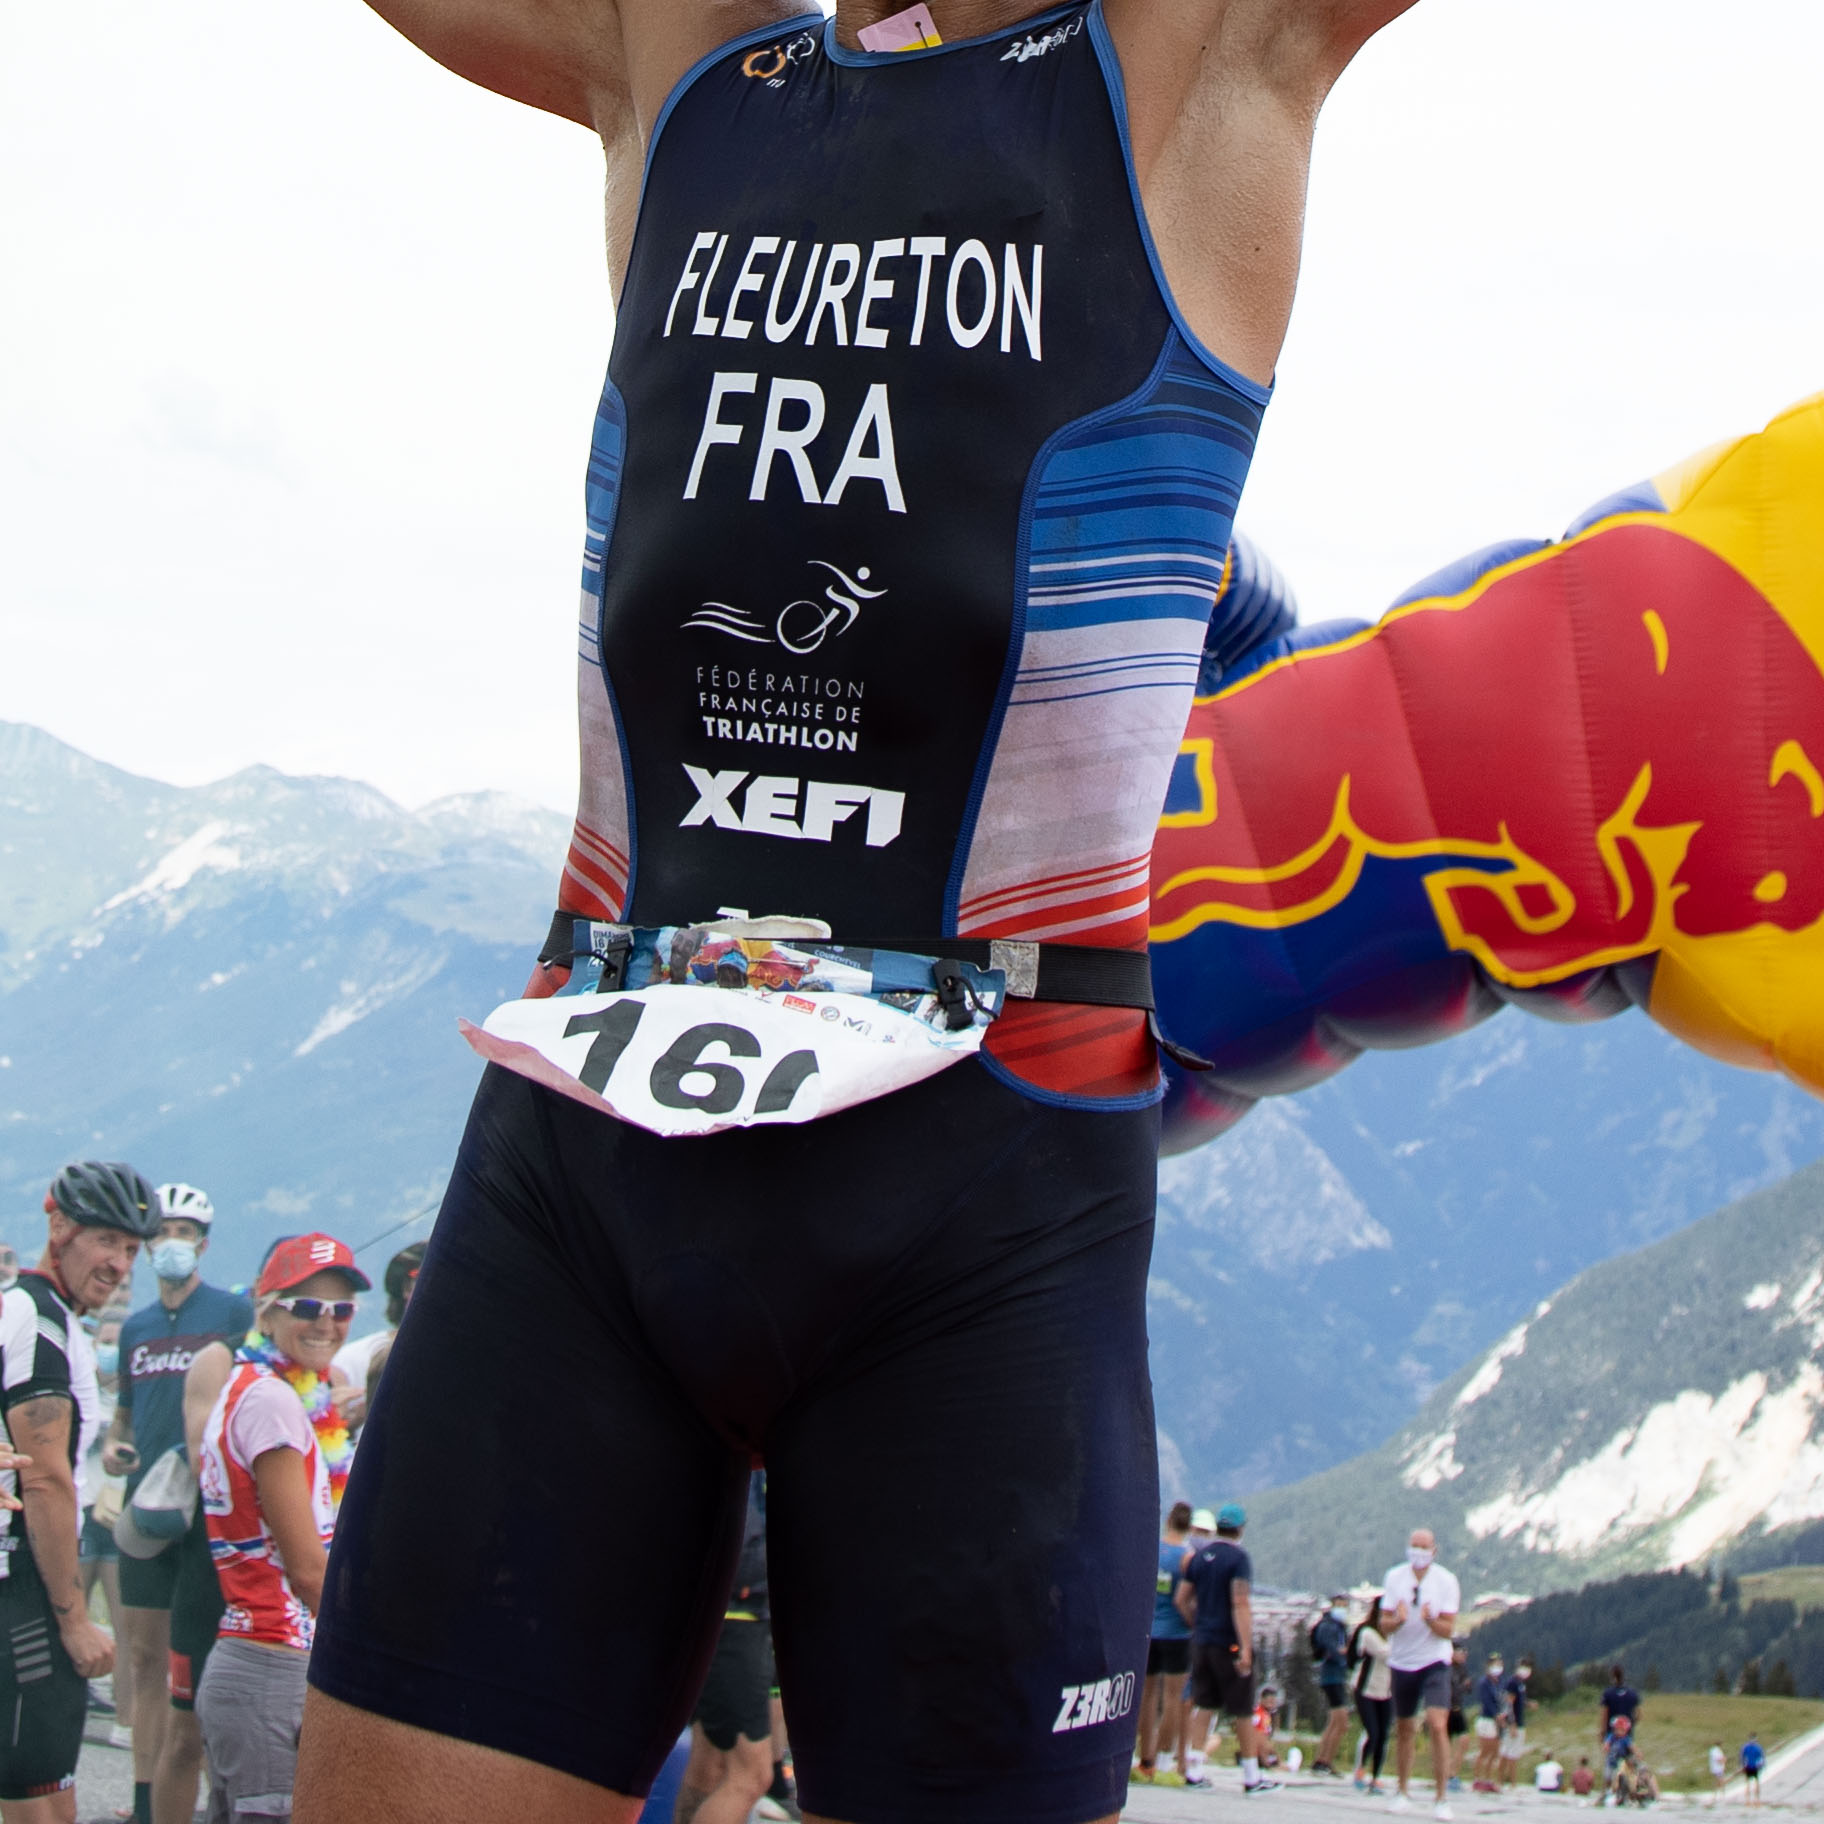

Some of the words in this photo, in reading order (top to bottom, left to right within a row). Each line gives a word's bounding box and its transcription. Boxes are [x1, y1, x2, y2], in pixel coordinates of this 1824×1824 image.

[663, 230, 1044, 362] FLEURETON
[683, 371, 907, 514] FRA
[696, 664, 865, 700] FÉDÉRATION
[699, 691, 824, 720] FRANÇAISE
[835, 706, 862, 724] DE
[702, 715, 859, 753] TRIATHLON
[678, 762, 907, 849] XEFI
